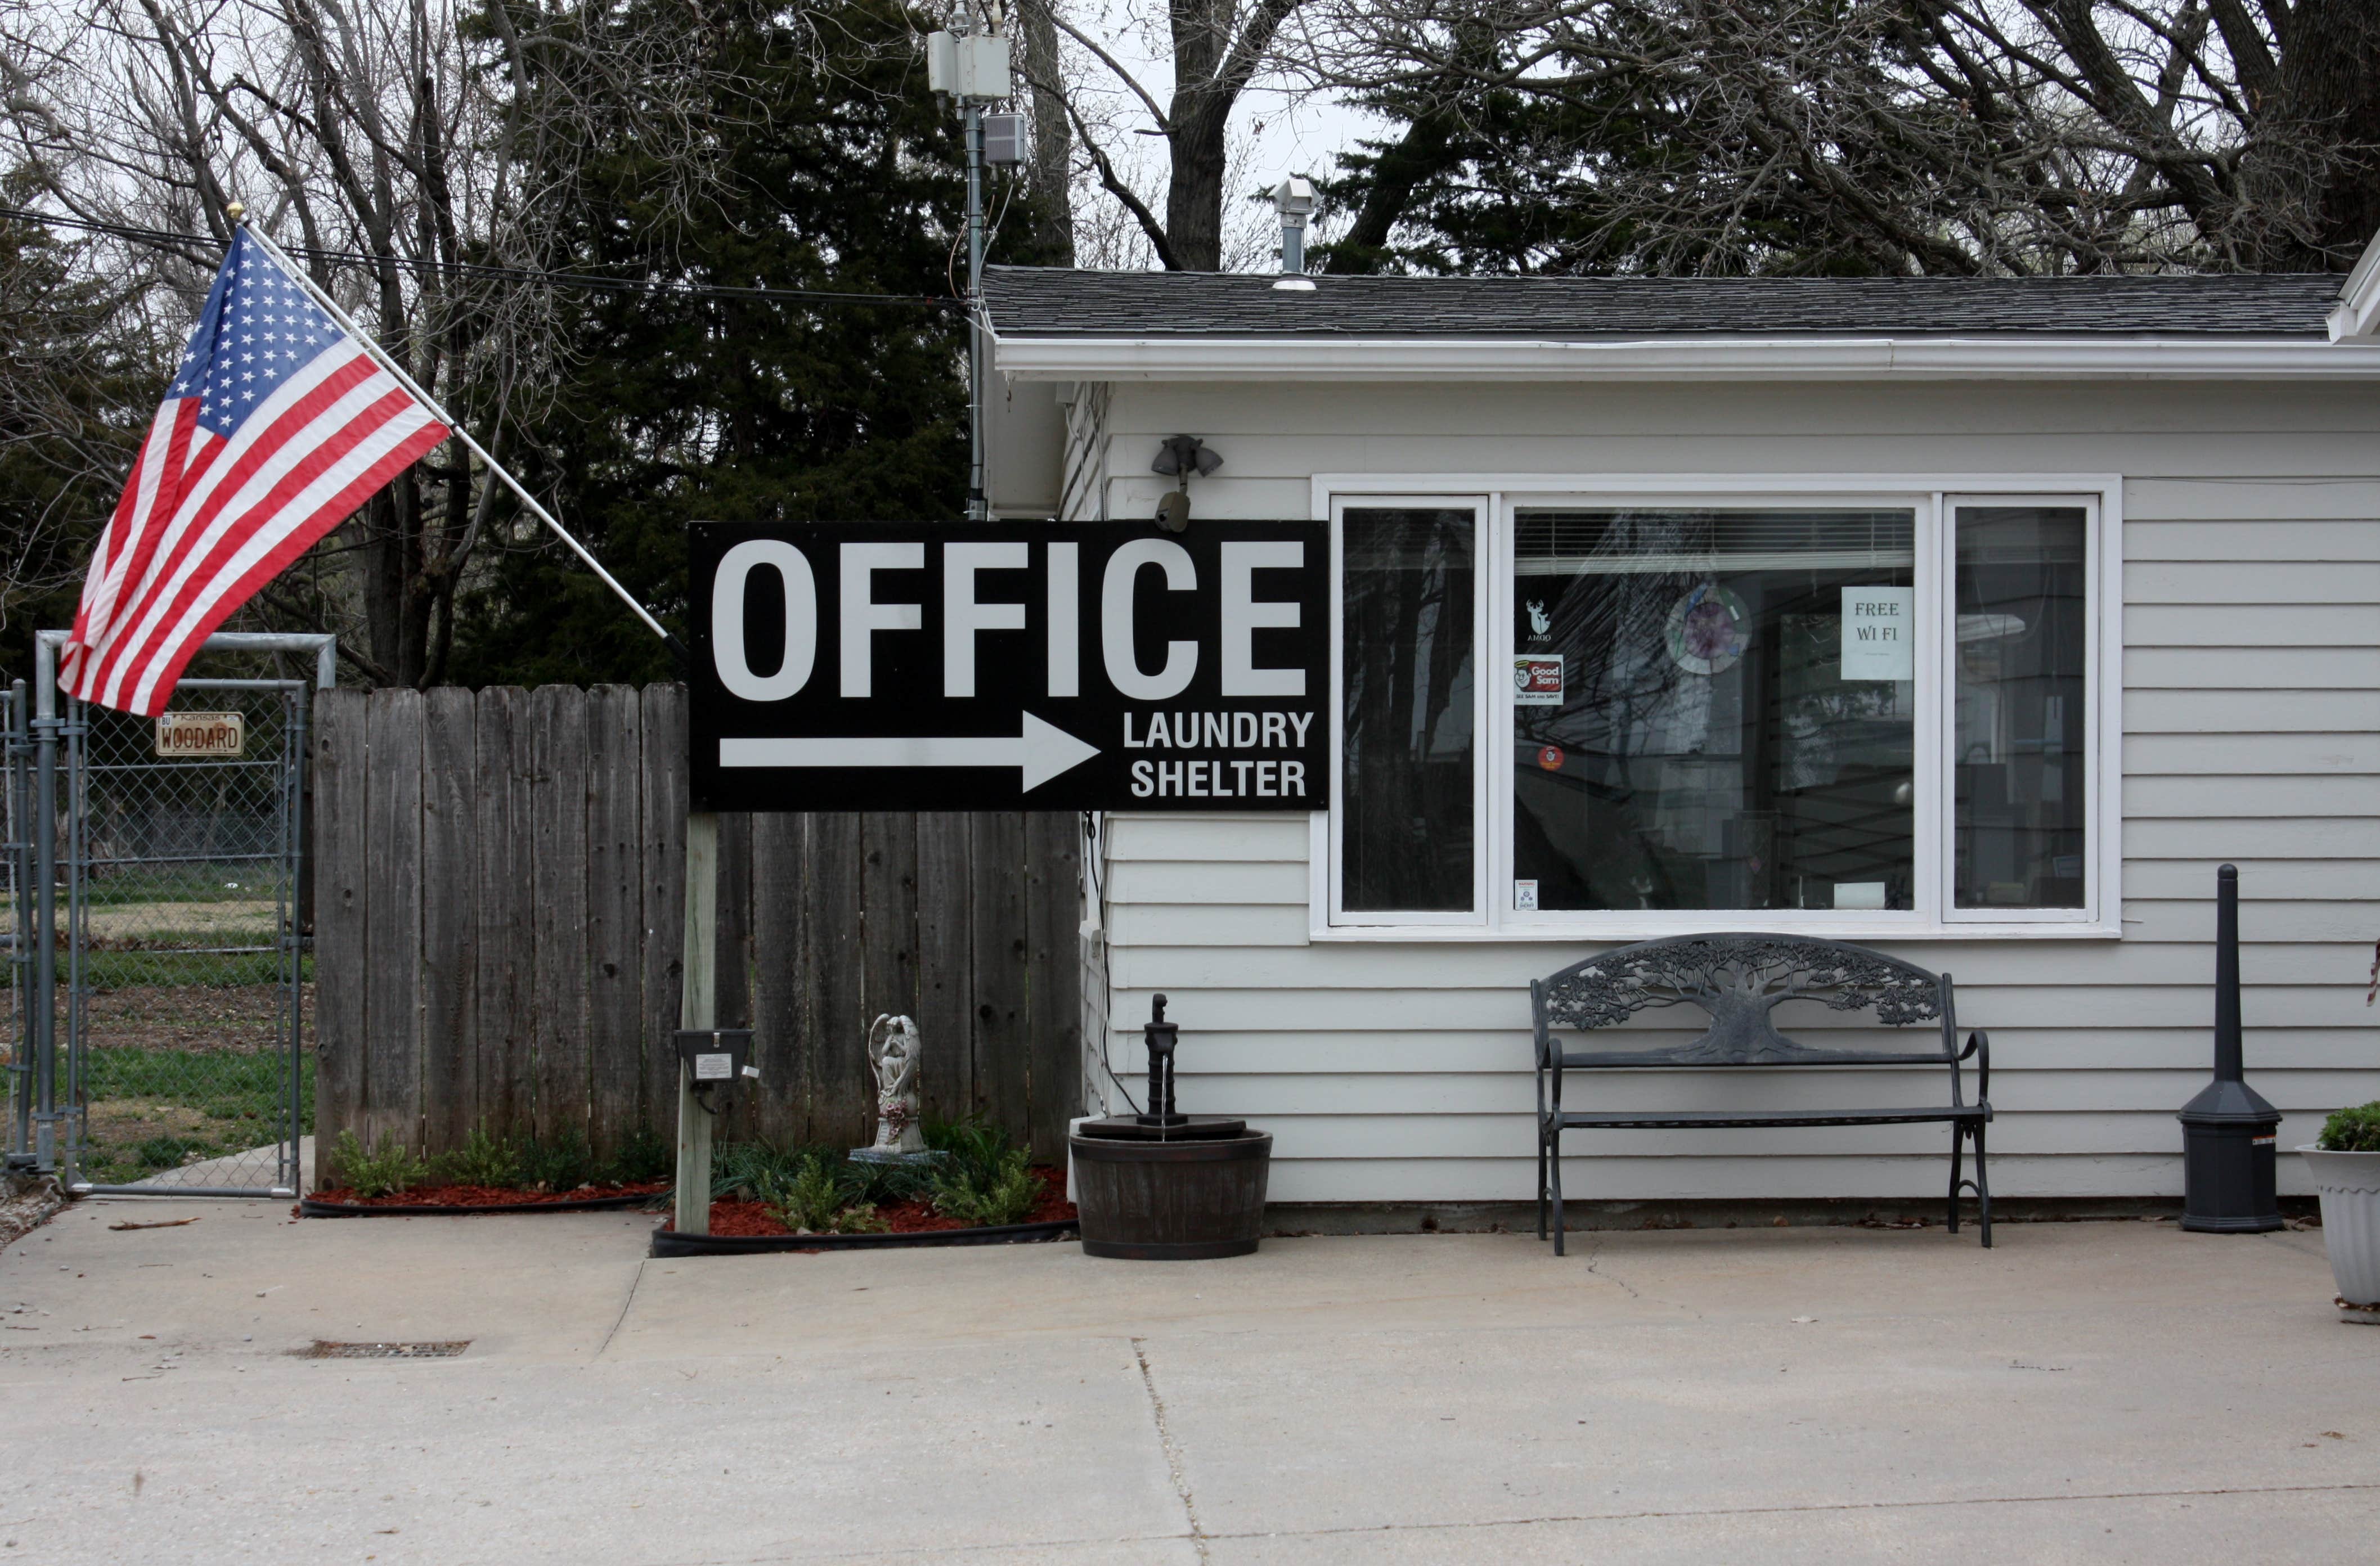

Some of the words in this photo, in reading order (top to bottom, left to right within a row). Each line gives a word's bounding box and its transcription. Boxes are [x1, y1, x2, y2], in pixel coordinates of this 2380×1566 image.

[1855, 602, 1899, 616] FREE
[712, 538, 1306, 701] OFFICE
[1857, 625, 1876, 641] WI
[1882, 627, 1897, 641] FI
[1532, 667, 1559, 675] Good
[1537, 676, 1559, 684] Sam
[162, 727, 237, 749] WOODARD
[1124, 712, 1314, 748] LAUNDRY
[1130, 759, 1306, 797] SHELTER
